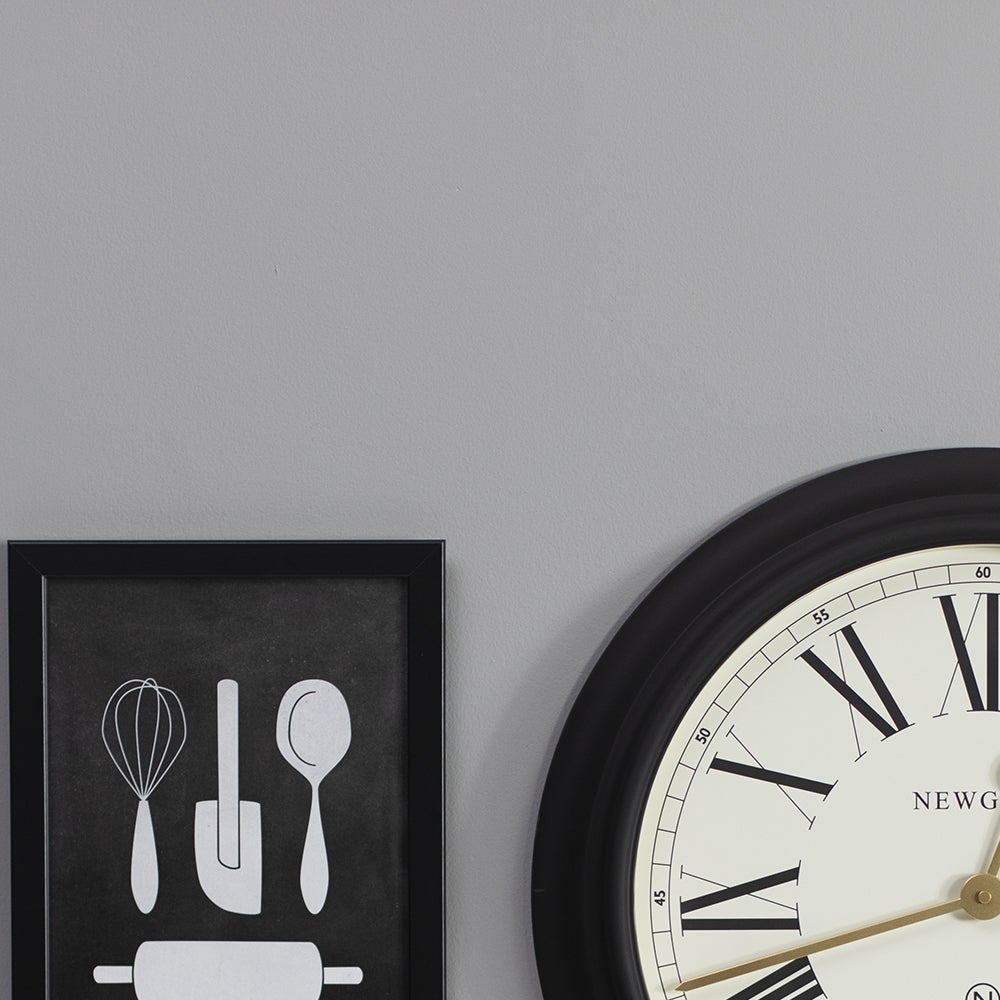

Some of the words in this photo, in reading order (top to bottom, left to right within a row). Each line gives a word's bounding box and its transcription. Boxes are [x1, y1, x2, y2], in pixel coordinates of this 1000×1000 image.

[975, 566, 991, 579] 60
[812, 609, 830, 625] 55
[794, 621, 915, 763] XI
[695, 727, 712, 745] 50
[706, 724, 838, 830] X
[653, 890, 666, 906] 45
[680, 860, 802, 936] IX
